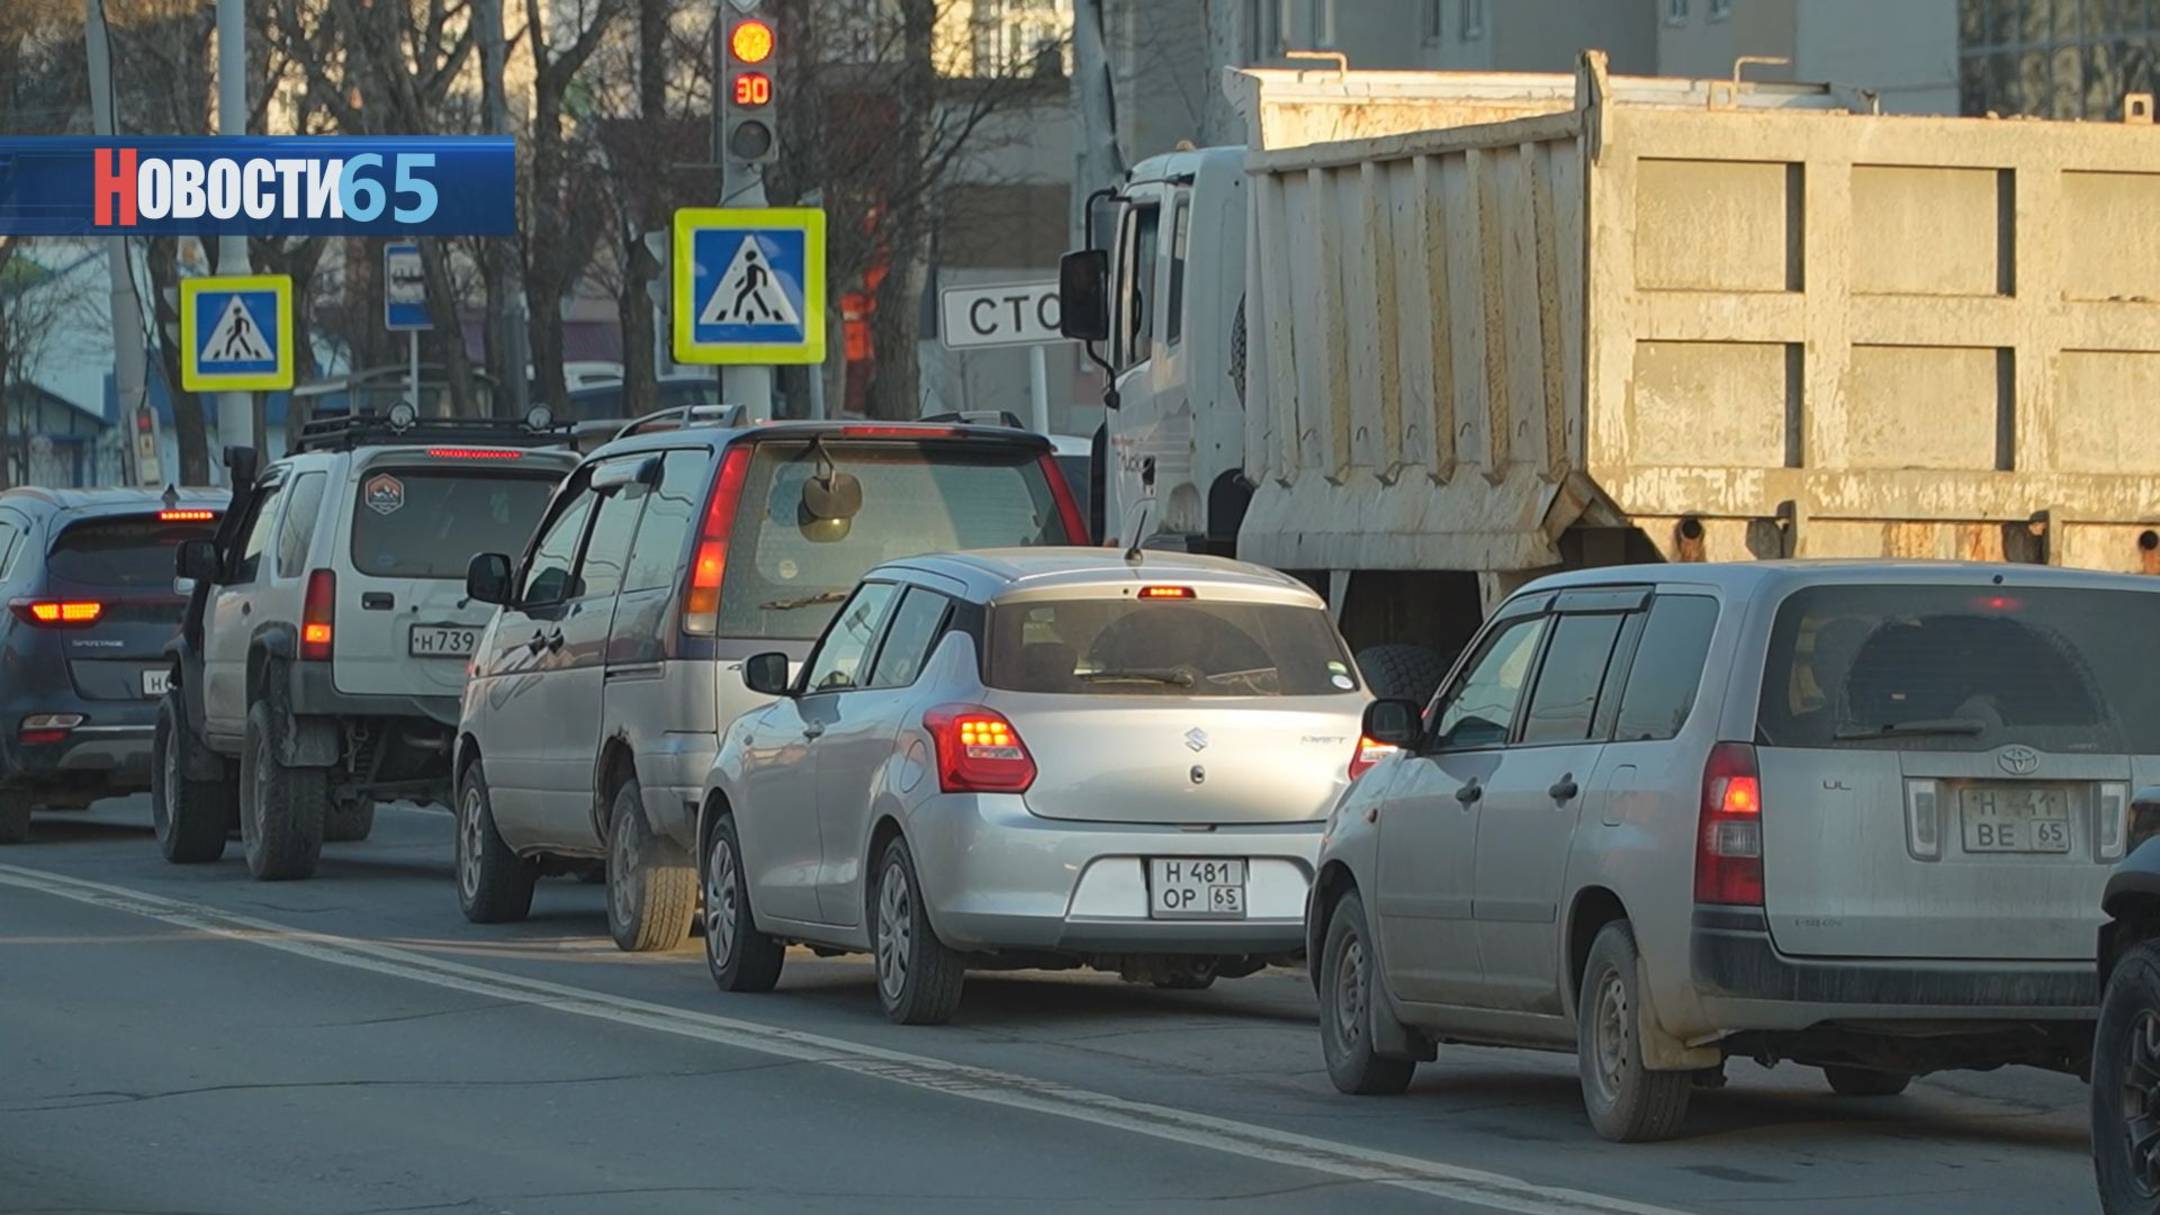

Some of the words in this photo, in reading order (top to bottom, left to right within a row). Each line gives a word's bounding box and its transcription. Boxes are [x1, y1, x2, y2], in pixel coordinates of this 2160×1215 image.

[737, 77, 768, 104] 30
[969, 292, 1062, 335] СТО
[1978, 823, 2015, 847] ВЕ
[2038, 823, 2062, 841] 65
[1190, 862, 1229, 883] 481
[1214, 888, 1237, 905] 65
